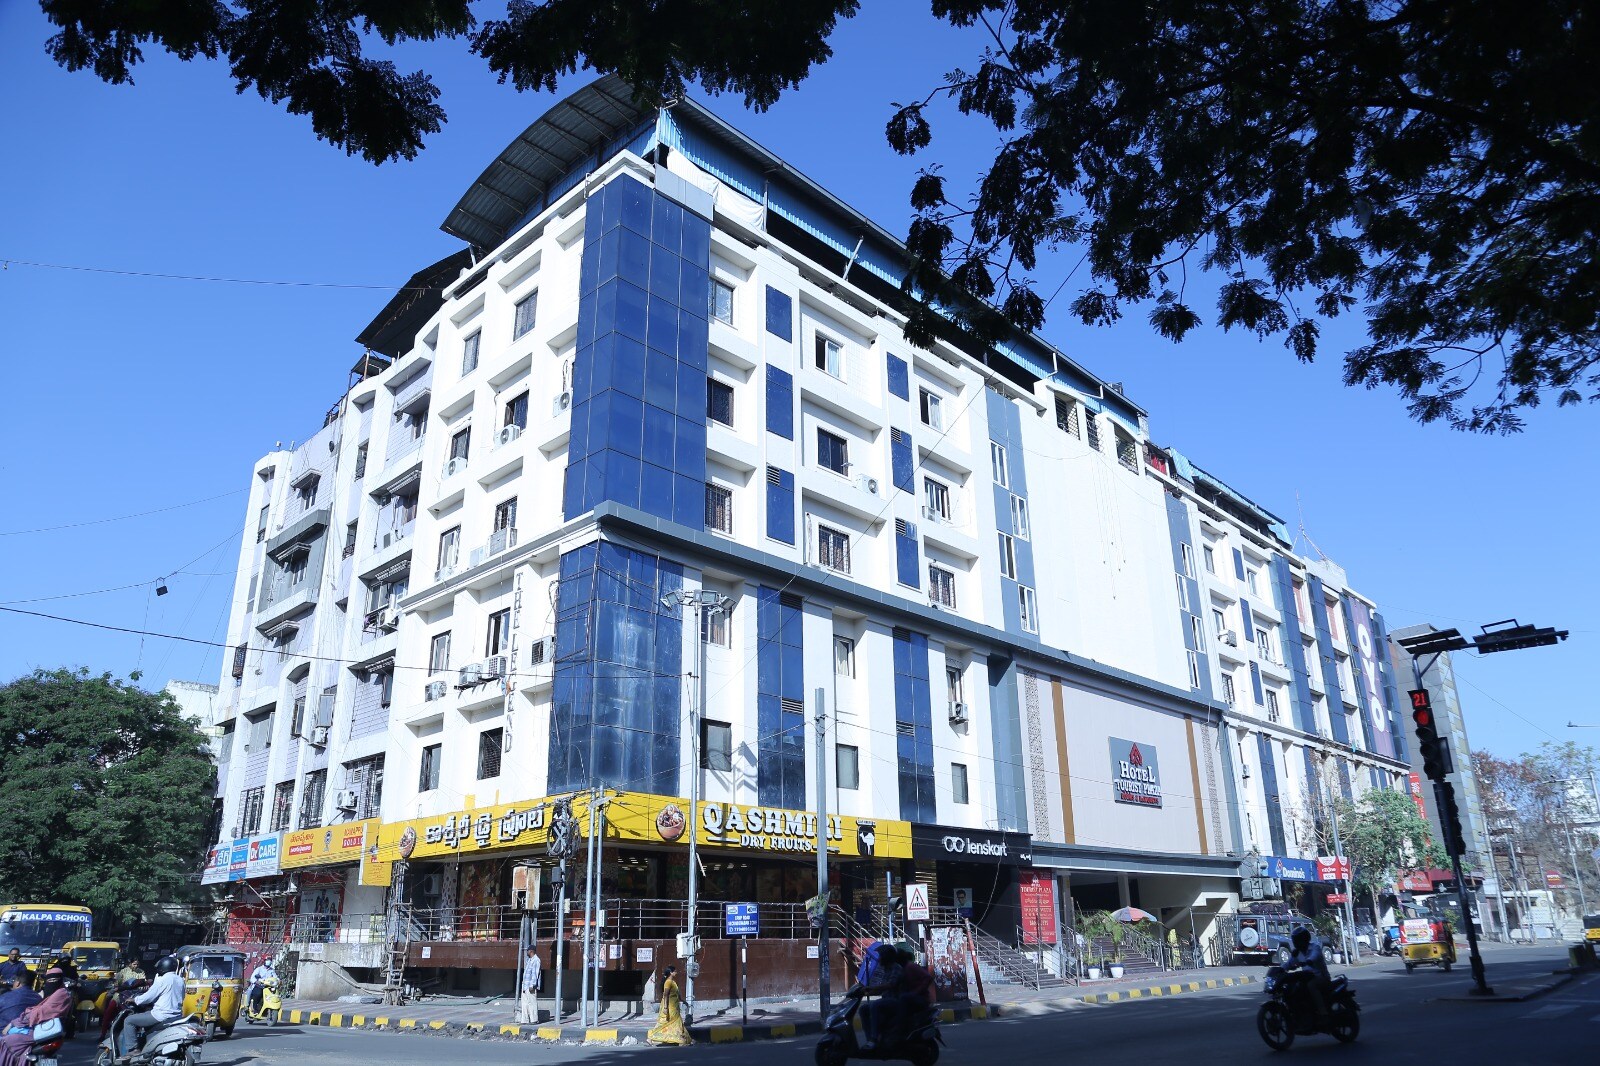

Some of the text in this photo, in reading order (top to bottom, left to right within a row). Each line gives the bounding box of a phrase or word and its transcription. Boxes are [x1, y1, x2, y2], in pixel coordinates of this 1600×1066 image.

[1357, 623, 1385, 732] OYO
[1413, 692, 1427, 707] 21
[1119, 760, 1155, 782] HOTEL
[1114, 779, 1162, 796] TOURIST PLAZA
[740, 834, 812, 851] DRY FRUITS
[966, 838, 1008, 857] lenskart
[259, 844, 276, 859] CARE
[22, 913, 89, 923] KALPA SCHOOL
